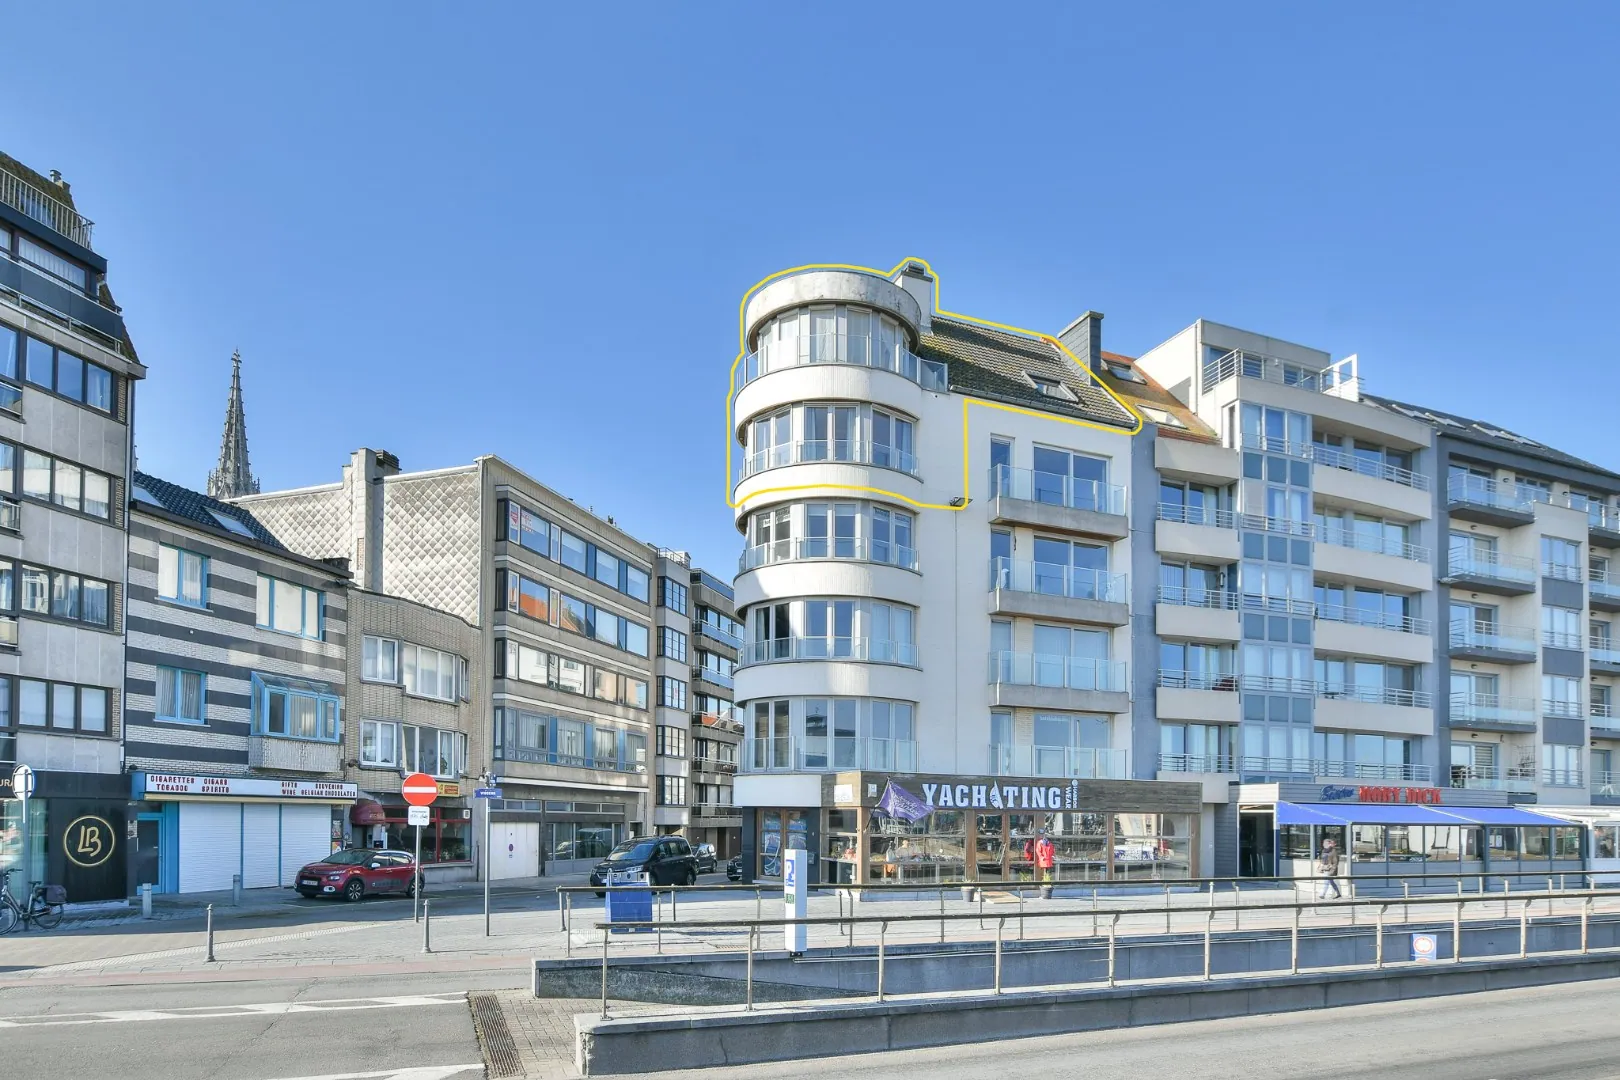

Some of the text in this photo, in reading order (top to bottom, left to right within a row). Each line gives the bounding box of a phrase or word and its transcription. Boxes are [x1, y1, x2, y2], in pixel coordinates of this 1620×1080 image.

[921, 783, 1061, 809] YACHTING
[1359, 786, 1401, 803] MOBY
[1405, 788, 1443, 805] DICK
